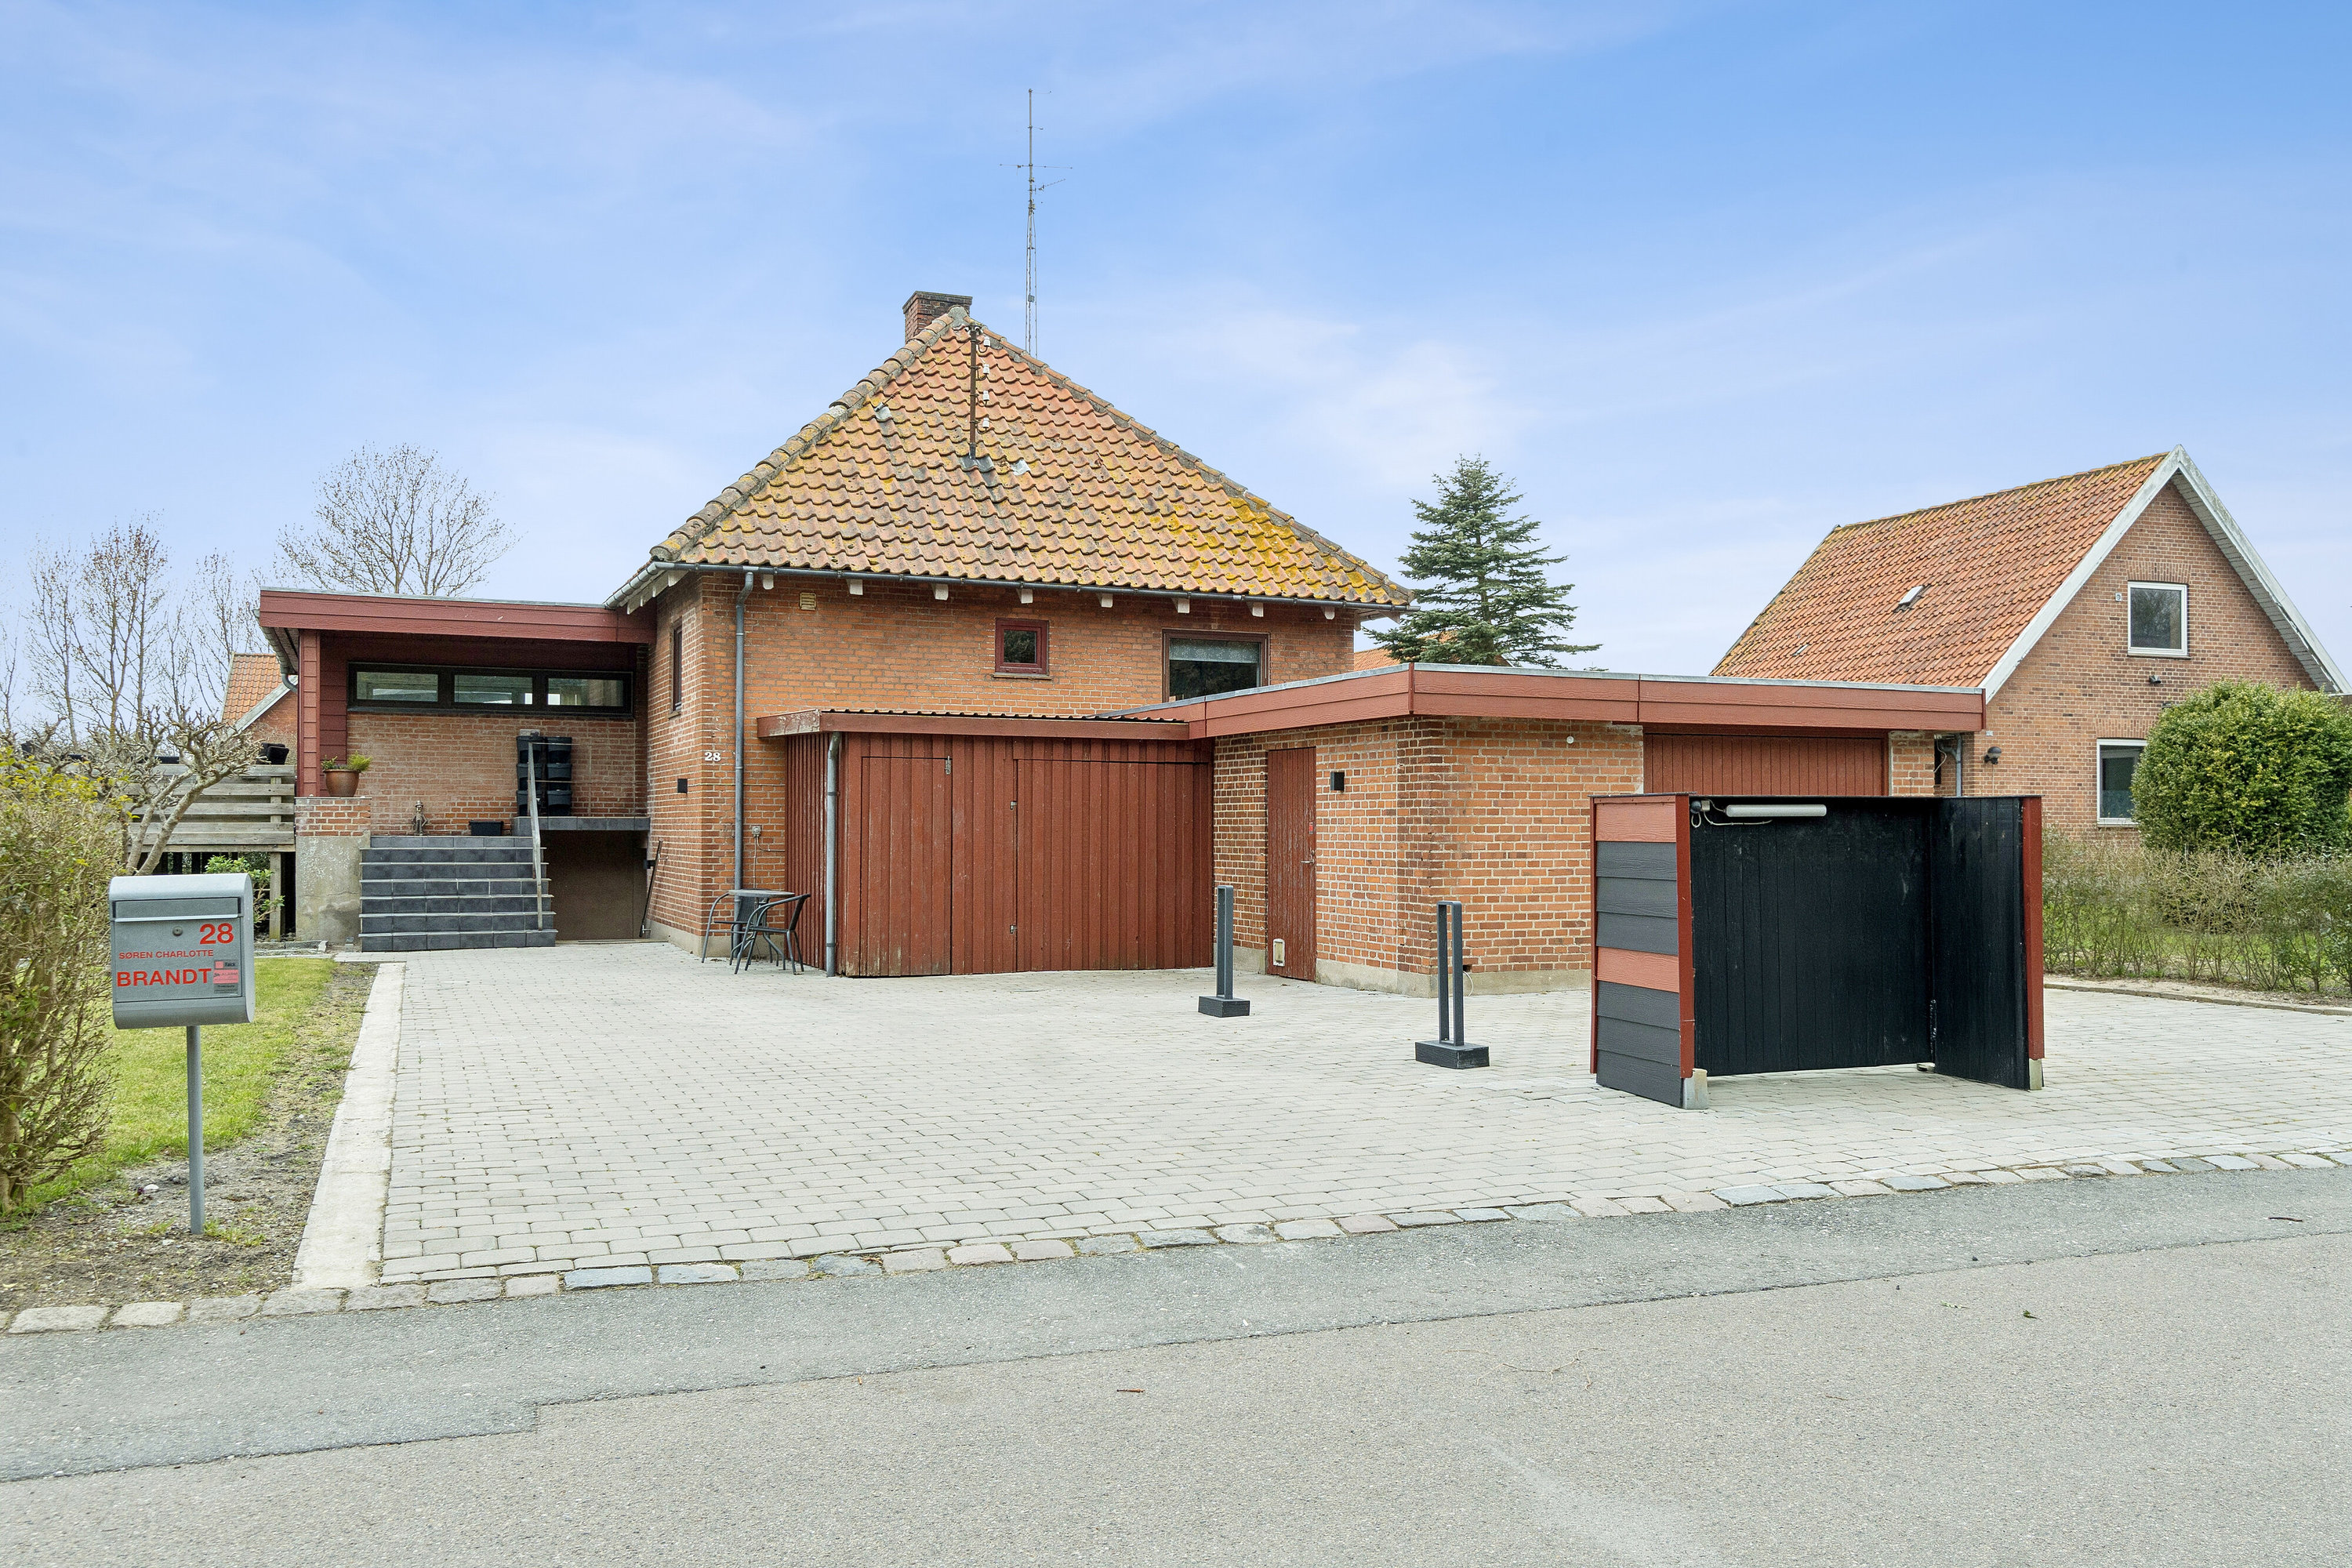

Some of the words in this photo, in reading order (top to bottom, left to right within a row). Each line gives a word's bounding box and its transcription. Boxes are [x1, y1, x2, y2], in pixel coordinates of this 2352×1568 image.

[704, 751, 721, 762] 28
[199, 923, 234, 945] 28
[118, 951, 153, 960] SØREN
[155, 949, 214, 958] CHARLOTTE
[117, 968, 212, 987] BRANDT
